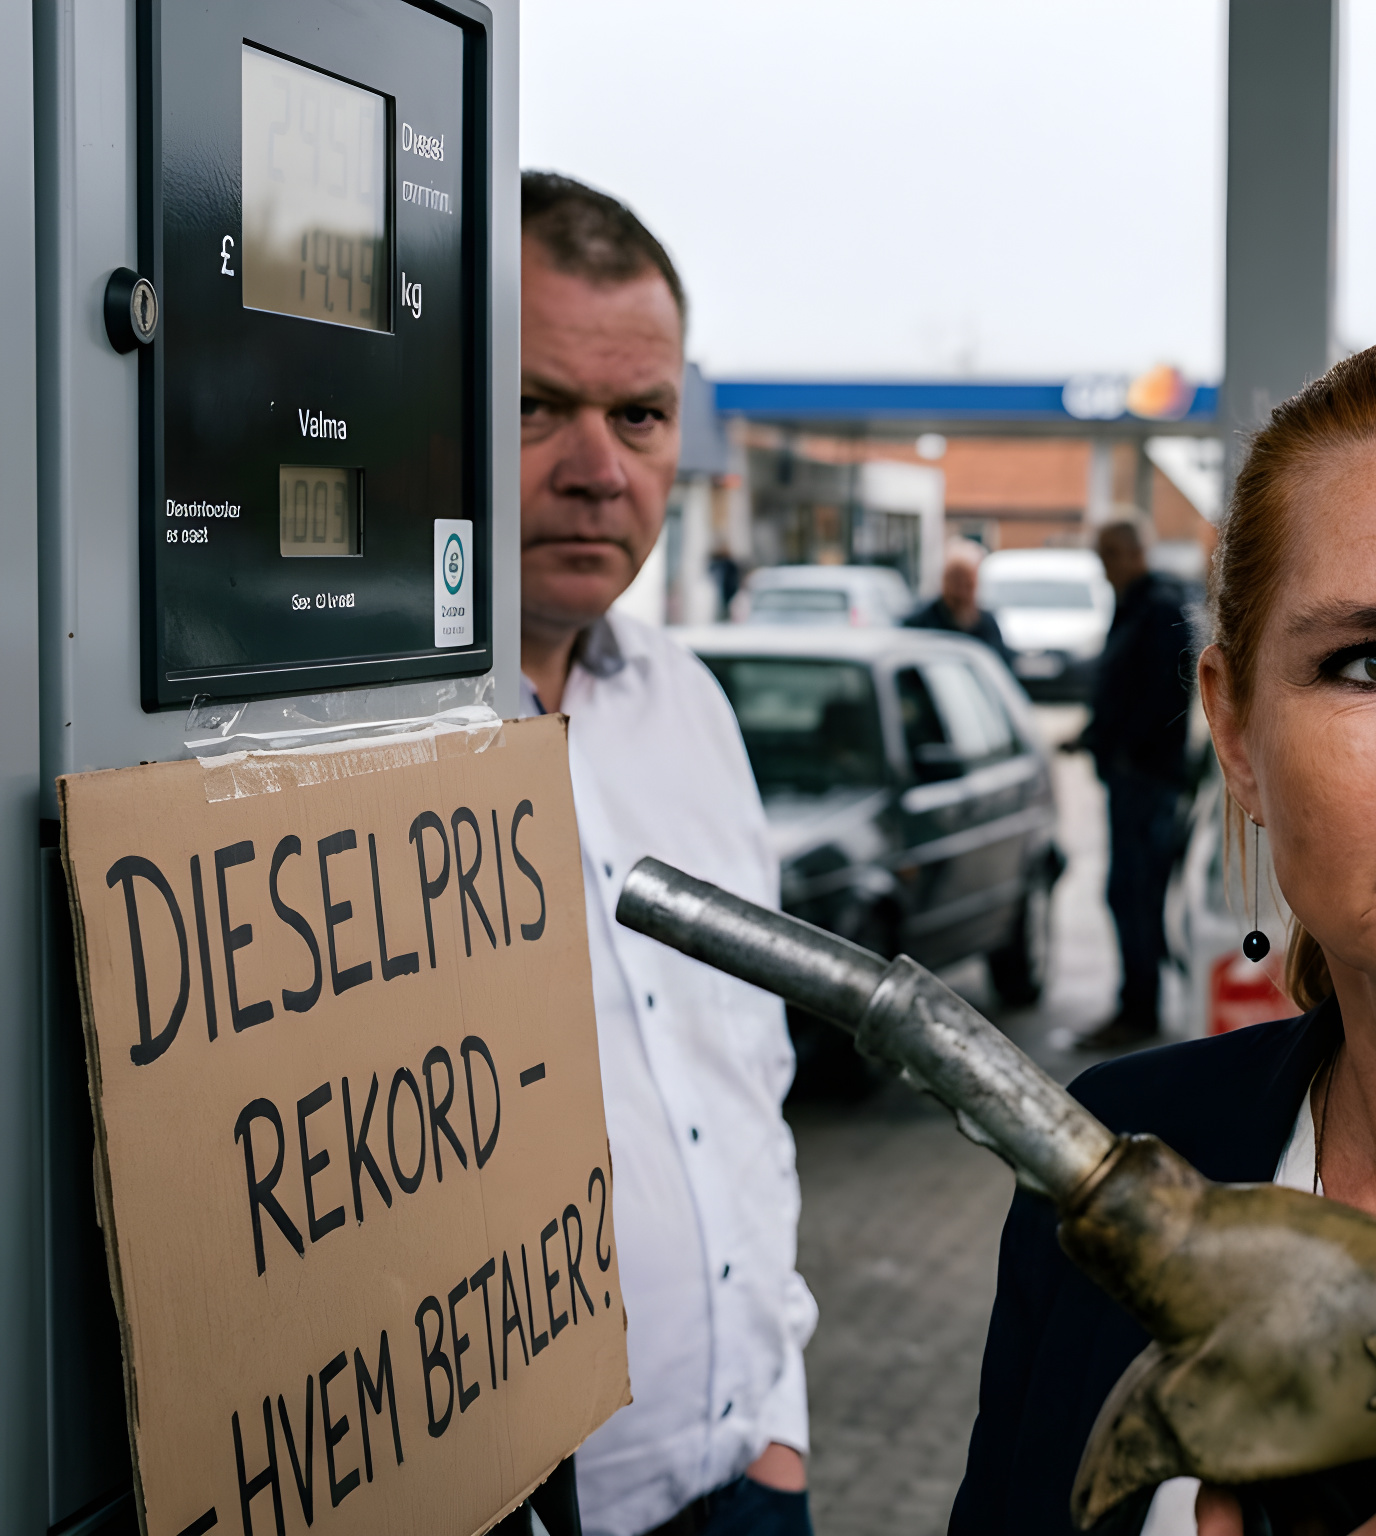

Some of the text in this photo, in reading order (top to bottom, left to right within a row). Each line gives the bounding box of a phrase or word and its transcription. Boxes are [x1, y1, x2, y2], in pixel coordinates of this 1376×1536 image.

[401, 271, 422, 319] kg
[234, 1035, 501, 1278] REKORD
[231, 1329, 404, 1536] HVEM
[414, 1166, 612, 1439] BETALER?
